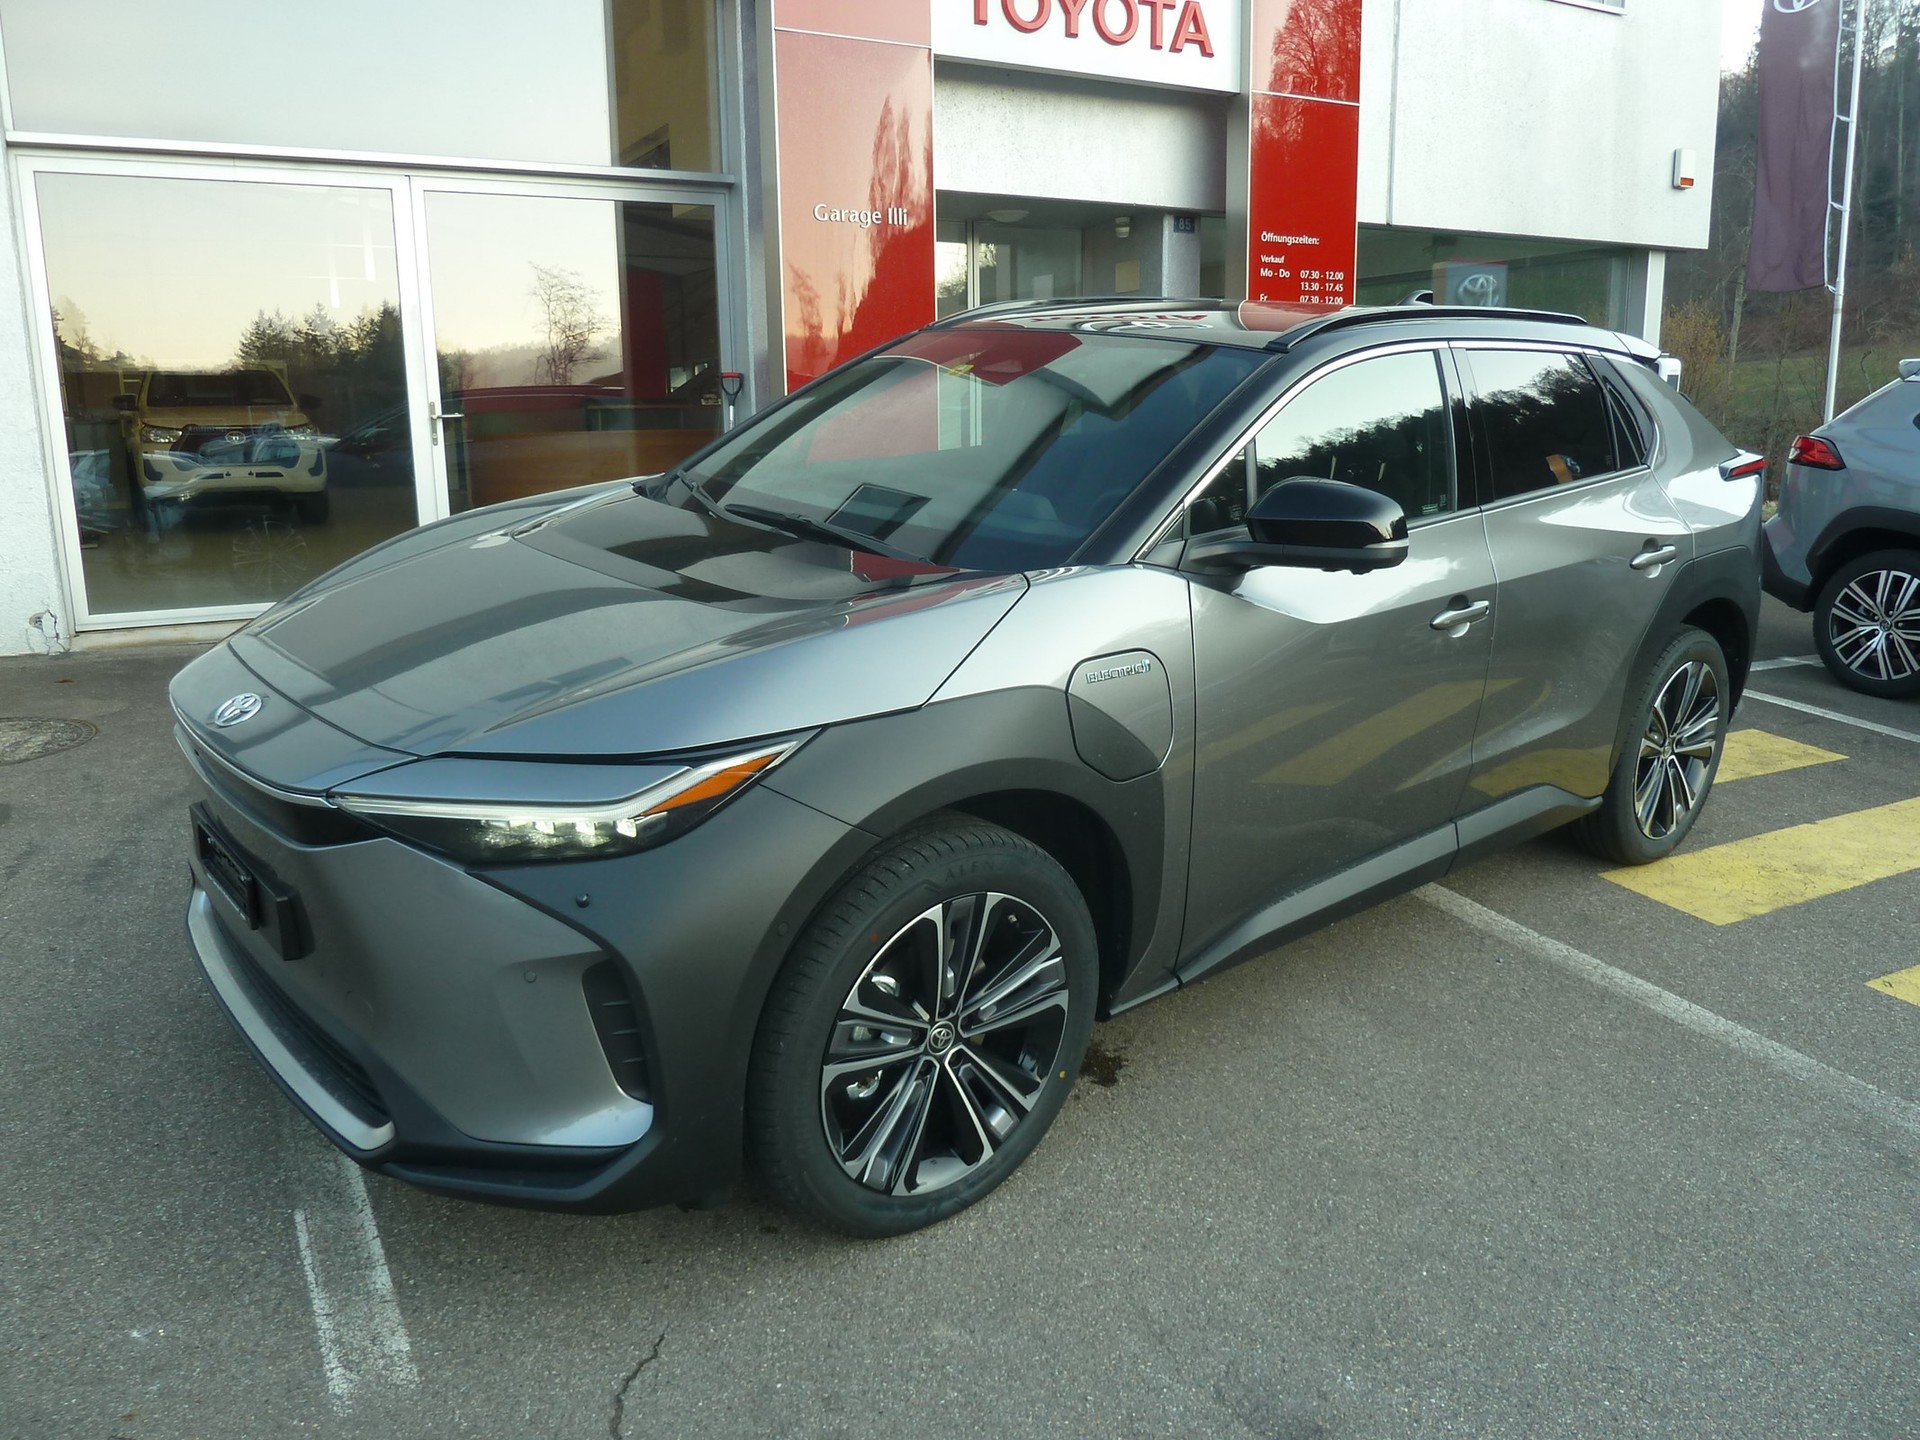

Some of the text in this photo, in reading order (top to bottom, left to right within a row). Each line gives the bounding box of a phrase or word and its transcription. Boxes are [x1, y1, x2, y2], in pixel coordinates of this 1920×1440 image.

[813, 203, 908, 229] Garage Illi
[1178, 217, 1192, 230] 85
[1261, 231, 1320, 246] Öffnungszeiten:
[1260, 254, 1285, 264] Verkauf
[1260, 268, 1273, 277] Mo
[1279, 268, 1290, 278] Do
[1300, 270, 1320, 279] 07.30
[1325, 271, 1344, 280] 12.00
[1300, 281, 1320, 291] 13.30
[1325, 282, 1344, 292] 17.45
[1325, 296, 1344, 305] 12.00
[1085, 663, 1144, 684] ELECTRIC
